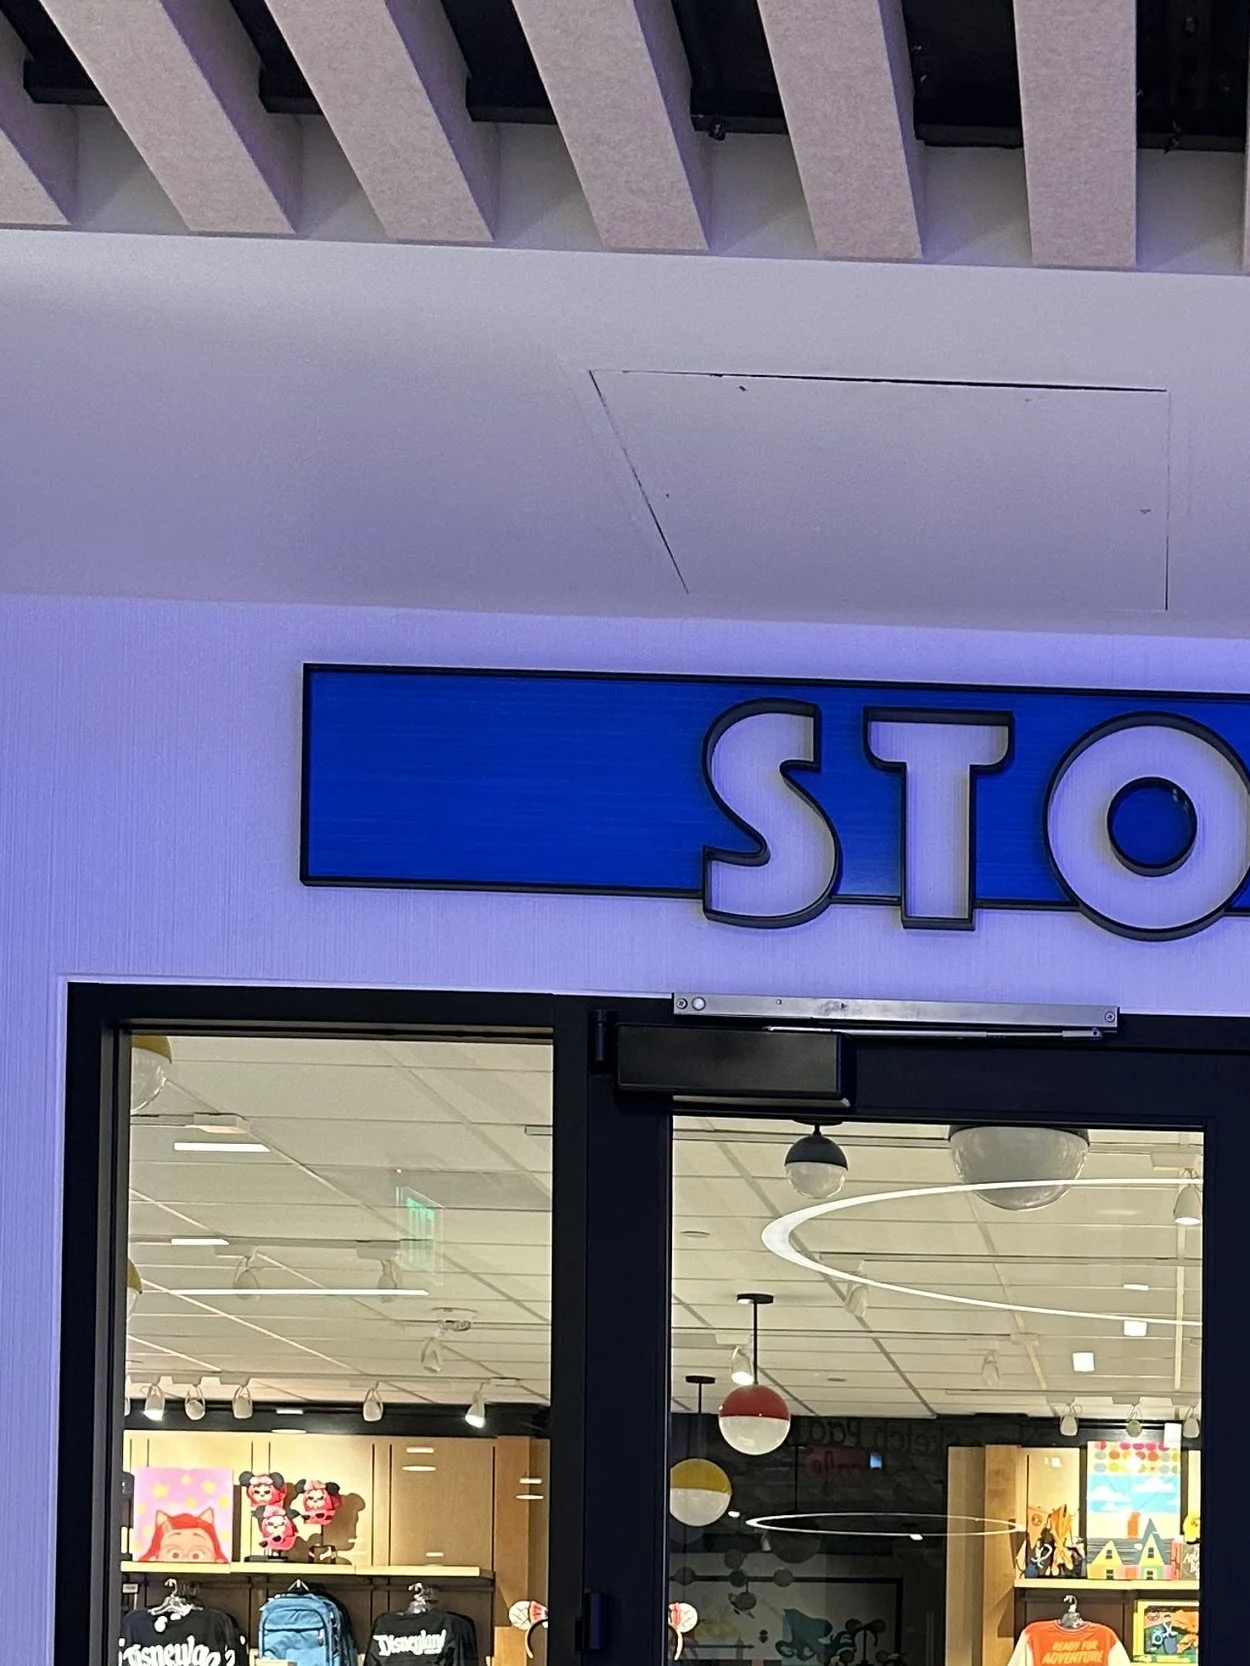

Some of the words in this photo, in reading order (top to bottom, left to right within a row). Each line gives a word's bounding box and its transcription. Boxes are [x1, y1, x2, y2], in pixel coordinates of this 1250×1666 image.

[1052, 1640, 1080, 1651] READY
[1081, 1639, 1098, 1650] FOR
[1041, 1650, 1104, 1664] ADVENTURE
